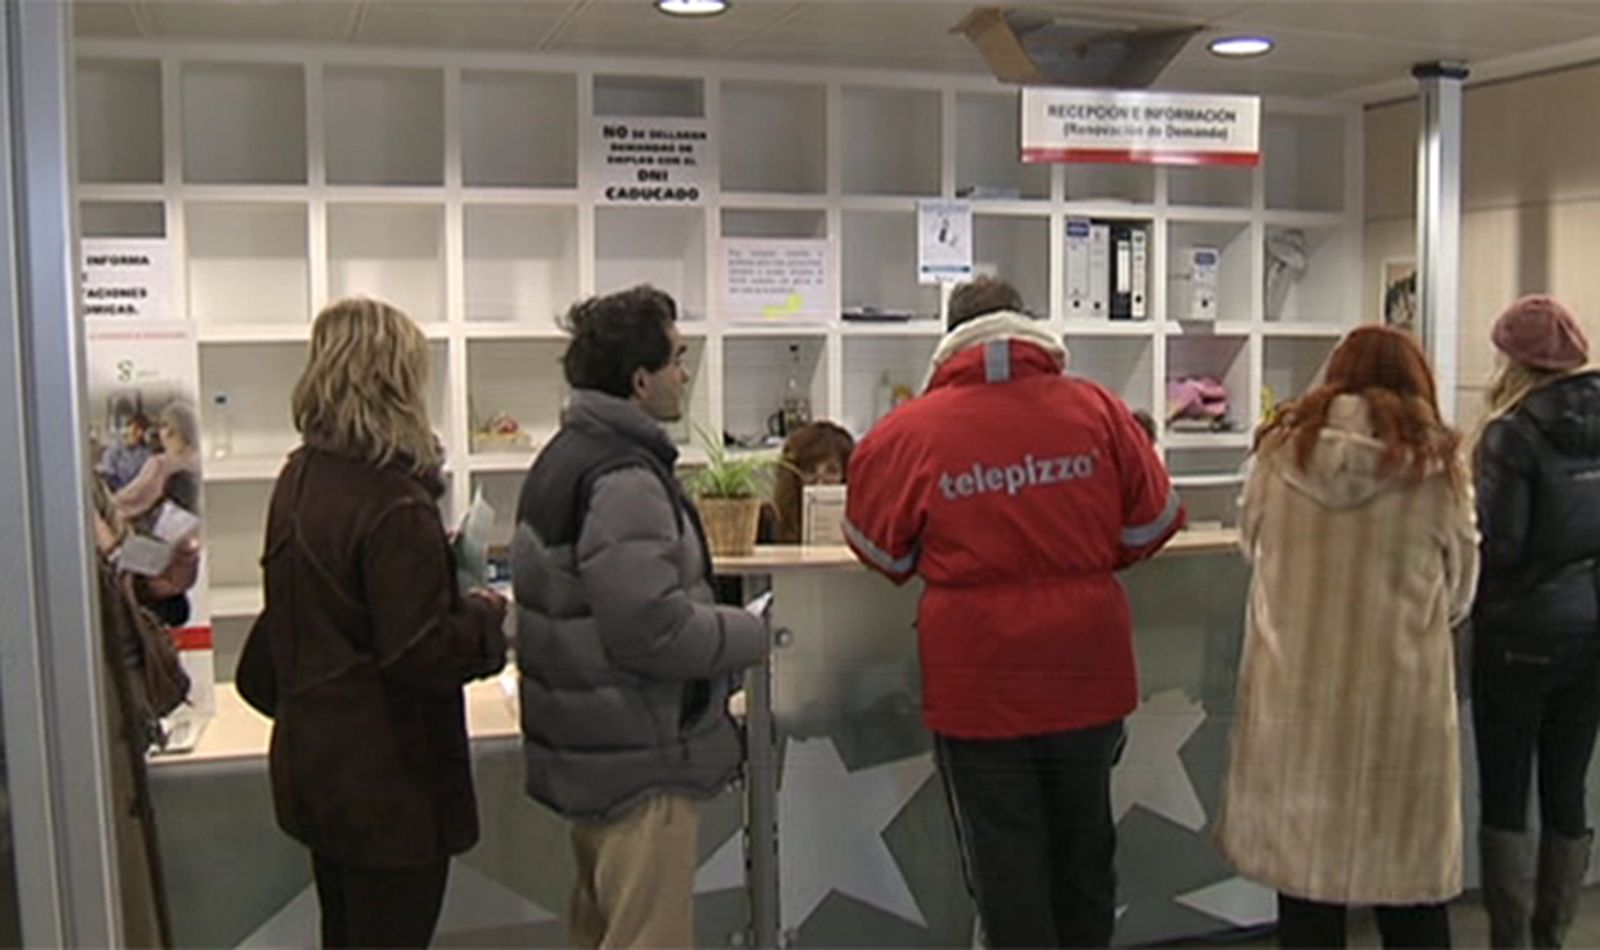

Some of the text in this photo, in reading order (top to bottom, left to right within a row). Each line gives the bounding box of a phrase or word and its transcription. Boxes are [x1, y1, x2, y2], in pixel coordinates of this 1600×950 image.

[1132, 107, 1141, 120] E
[603, 125, 628, 139] NO
[637, 169, 669, 182] DNI
[605, 187, 700, 201] CADUCADO
[86, 255, 150, 266] INFORMA
[938, 453, 1094, 499] telepizza
